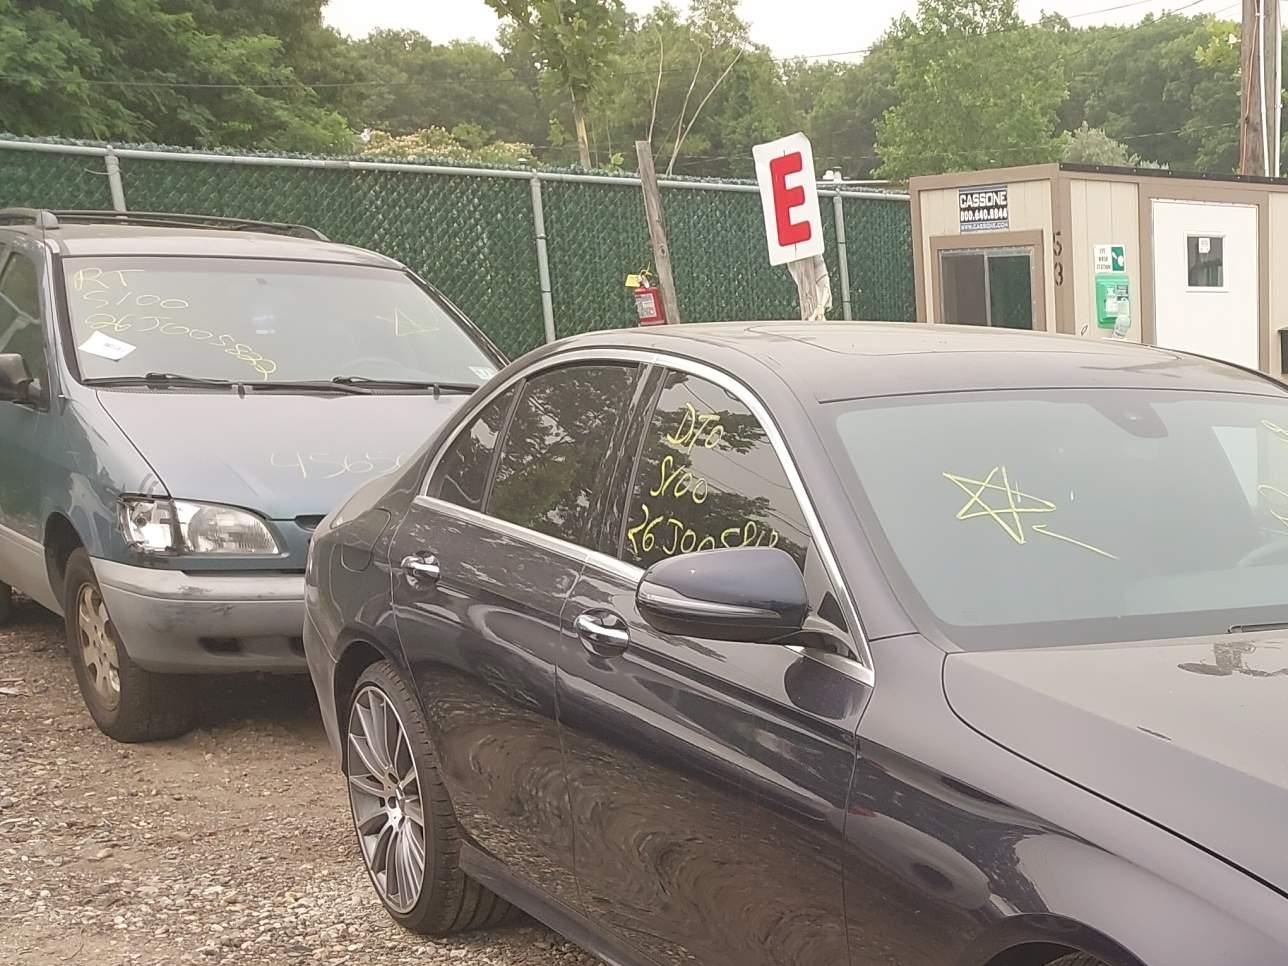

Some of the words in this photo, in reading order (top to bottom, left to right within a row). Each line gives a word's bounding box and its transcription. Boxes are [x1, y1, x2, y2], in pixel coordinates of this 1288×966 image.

[770, 151, 811, 247] E
[960, 192, 1007, 208] CASSONE
[270, 452, 402, 480] 4565
